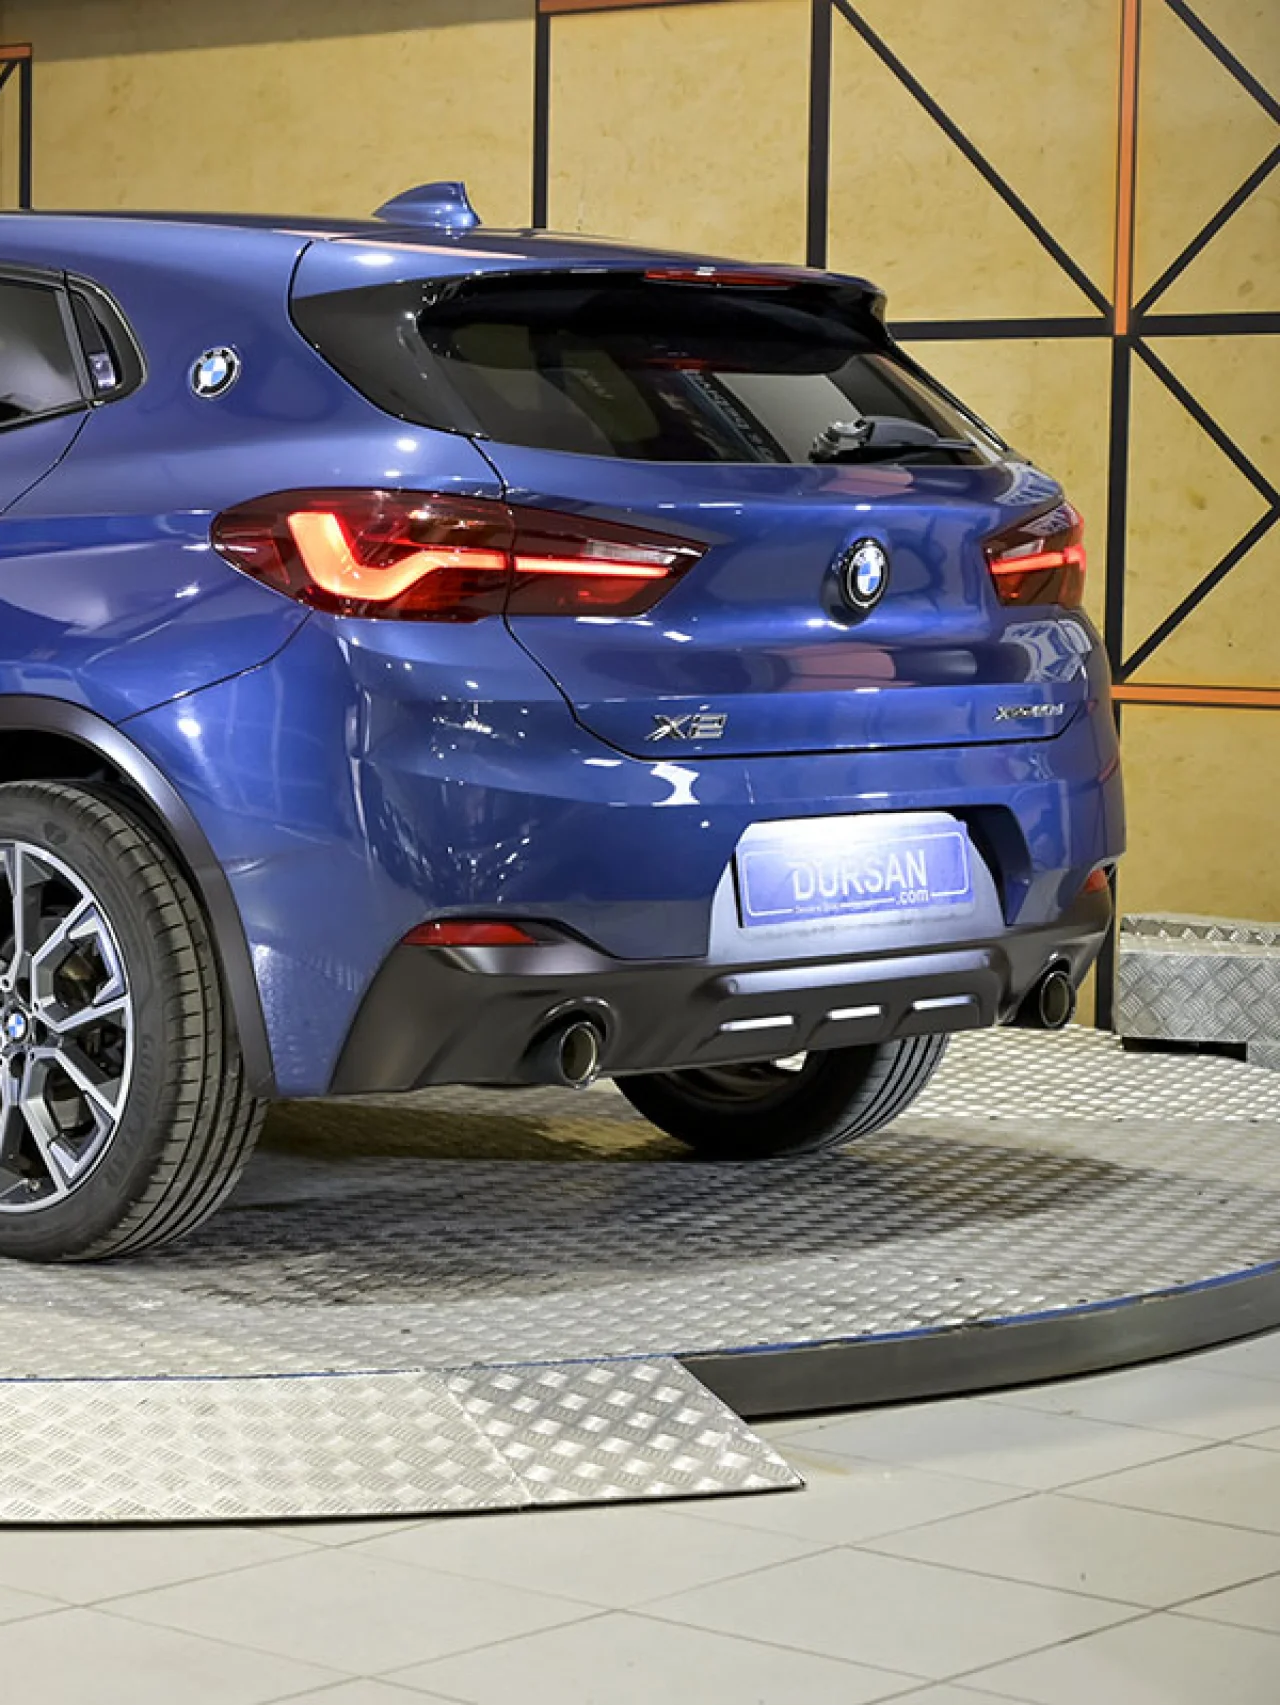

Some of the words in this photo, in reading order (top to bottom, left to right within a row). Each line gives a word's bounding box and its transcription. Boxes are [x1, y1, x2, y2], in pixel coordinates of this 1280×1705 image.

[644, 713, 727, 741] X2
[787, 849, 928, 901] DURSAN
[896, 888, 930, 906] .com
